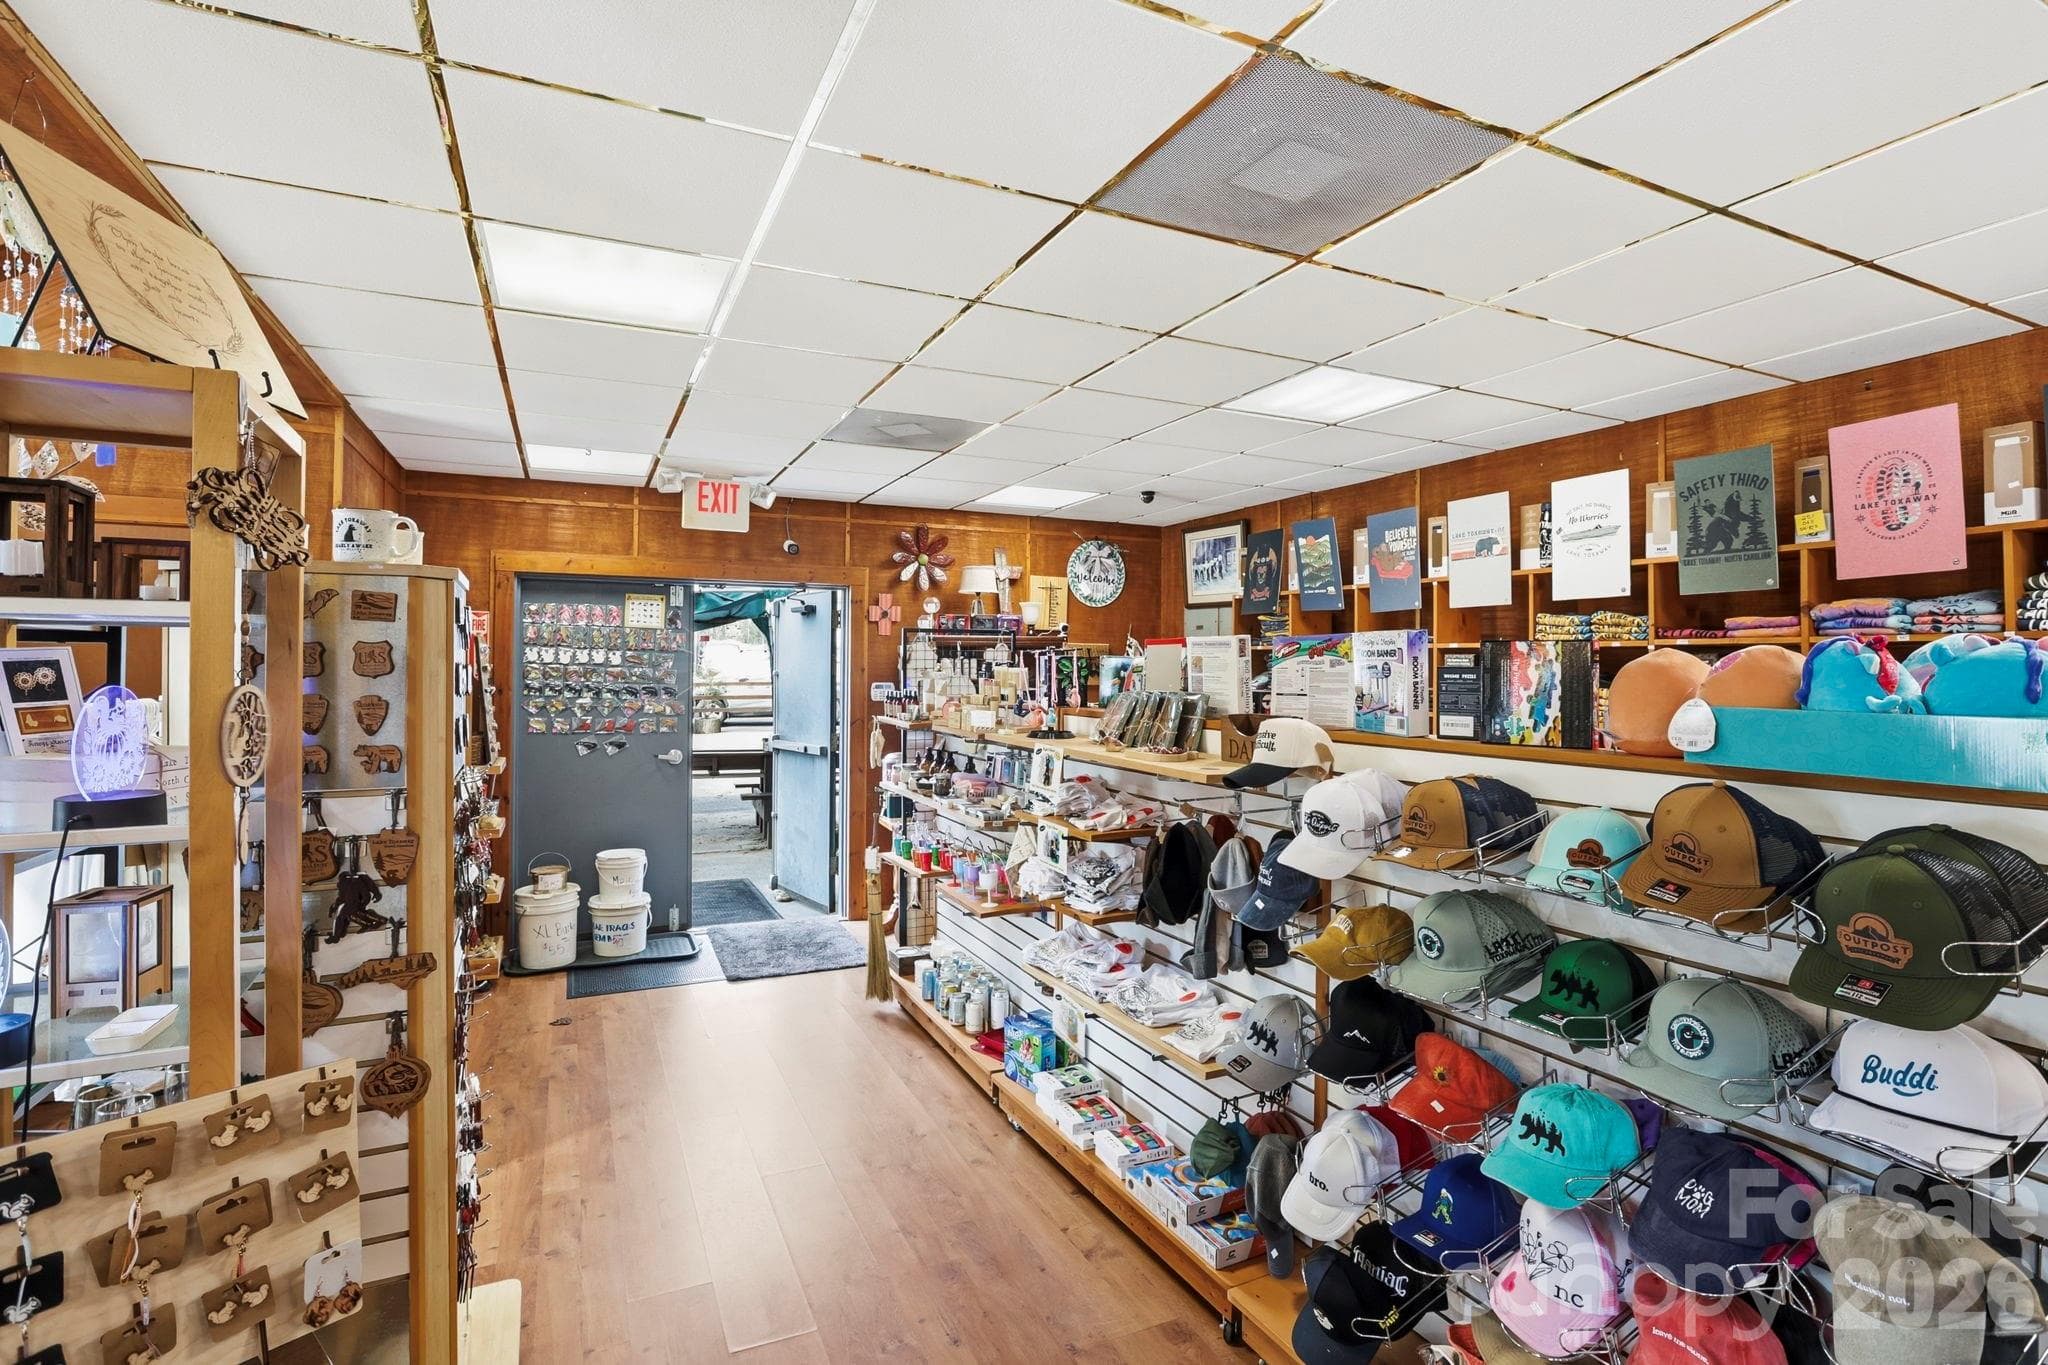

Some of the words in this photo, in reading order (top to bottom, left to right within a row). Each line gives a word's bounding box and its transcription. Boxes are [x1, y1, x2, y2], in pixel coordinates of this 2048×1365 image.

[698, 481, 740, 514] EXIT
[1679, 474, 1725, 502] SAFETY
[1729, 473, 1769, 491] THIRD
[1854, 501, 1880, 511] LAKE
[1883, 493, 1938, 506] TOXAWAY
[1579, 512, 1609, 522] Worries
[1385, 527, 1408, 543] BELIEVE
[1409, 525, 1417, 538] IN
[1388, 538, 1417, 552] YOURSELF
[472, 618, 486, 631] FIRE
[1571, 852, 1607, 866] OUTPO
[1664, 846, 1710, 866] OUTPOST
[532, 923, 552, 939] XL
[1843, 933, 1911, 955] OUTPOST
[1861, 1054, 1938, 1095] Buddi
[1309, 1171, 1329, 1192] bro.
[1684, 1178, 1714, 1207] DG
[1674, 1187, 1710, 1219] MOM
[1553, 1284, 1585, 1308] nc
